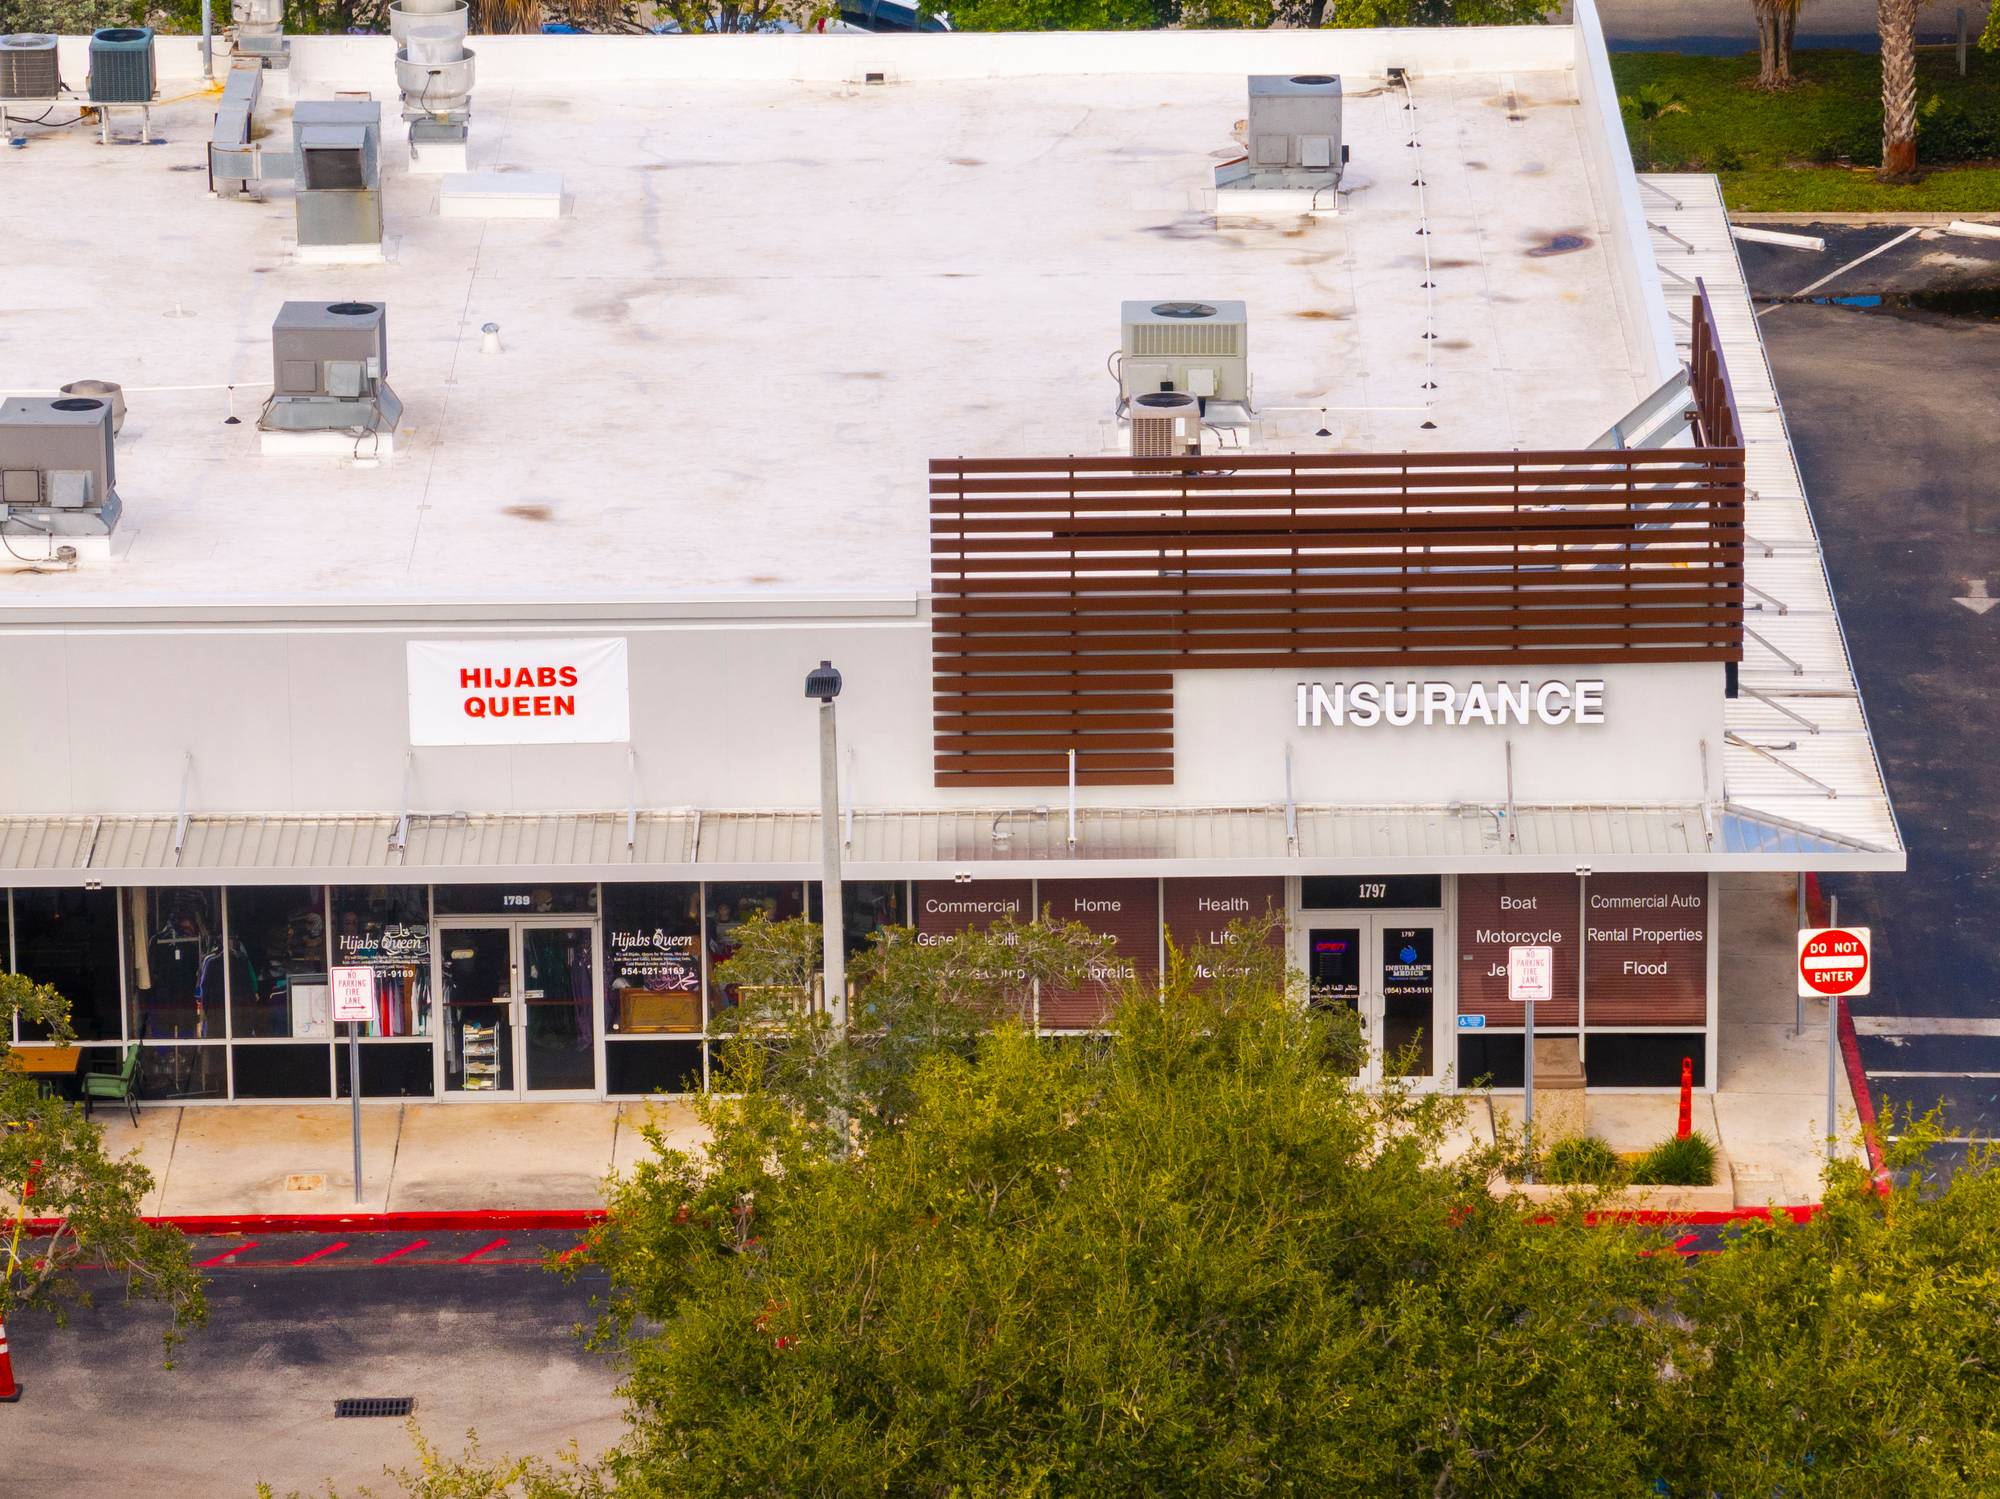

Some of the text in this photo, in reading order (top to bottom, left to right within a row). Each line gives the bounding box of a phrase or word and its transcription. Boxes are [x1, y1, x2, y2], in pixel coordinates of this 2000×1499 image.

[460, 666, 578, 688] HIJABS
[464, 695, 575, 718] QUEEN
[1296, 680, 1605, 727] INSURANCE
[1359, 884, 1386, 898] 1797
[503, 895, 530, 905] 1789
[926, 899, 1020, 913] Commercial
[1074, 898, 1121, 911] Home
[1199, 898, 1249, 911] Health
[1500, 896, 1537, 910] Boat
[1591, 894, 1701, 908] Commercial Auto
[340, 933, 379, 954] Hijabs
[381, 930, 421, 955] Queen
[611, 928, 692, 951] Hijabs Queen
[1476, 930, 1562, 945] Motorcycle
[1588, 927, 1703, 944] Rental Properties
[1810, 942, 1859, 954] DO NOT
[1623, 961, 1667, 975] Flood
[1814, 971, 1853, 982] ENTER
